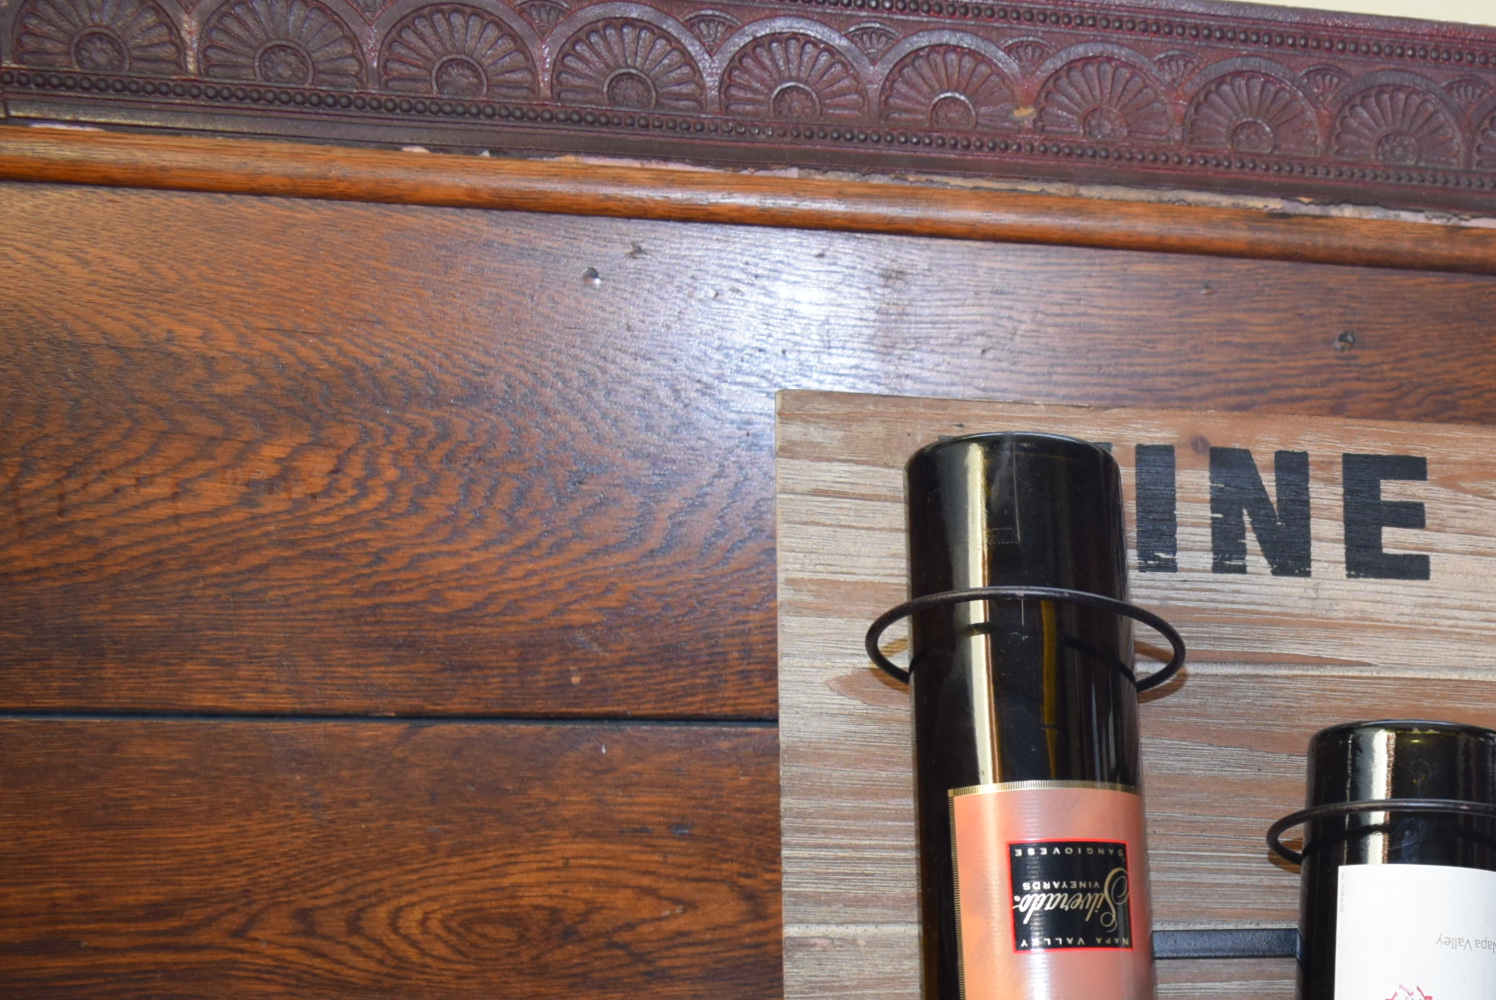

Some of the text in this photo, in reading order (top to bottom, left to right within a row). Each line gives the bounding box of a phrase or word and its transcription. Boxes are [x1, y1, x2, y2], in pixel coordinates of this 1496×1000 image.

[1093, 442, 1431, 582] INE
[1014, 848, 1123, 856] SANGIOVESE
[1023, 881, 1100, 890] VINEYARDS
[1012, 867, 1128, 932] Silverado
[1020, 937, 1129, 947] NAPA VALLEY
[1436, 933, 1472, 951] Valley
